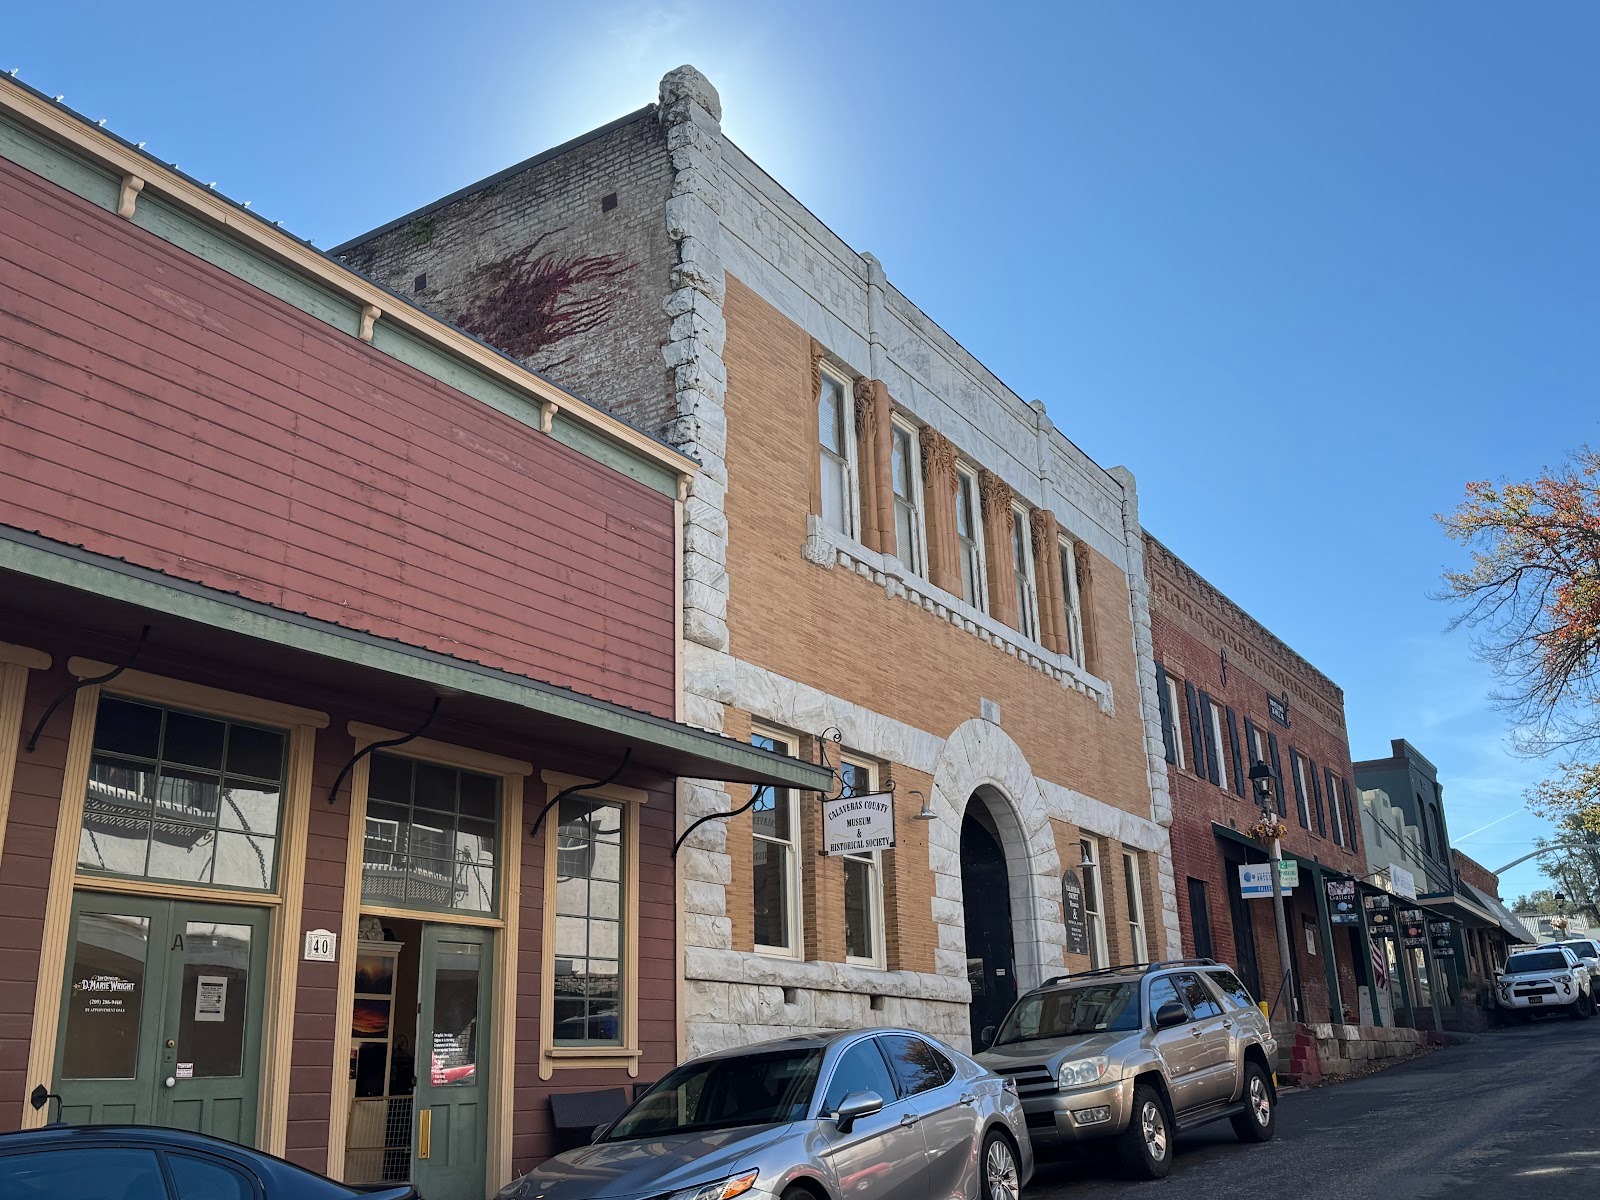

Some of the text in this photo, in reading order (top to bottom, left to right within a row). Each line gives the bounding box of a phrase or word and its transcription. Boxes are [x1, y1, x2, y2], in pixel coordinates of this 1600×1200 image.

[828, 801, 889, 820] CALAVERAS COUNTY
[847, 817, 871, 827] MUSEUM
[857, 829, 861, 838] &
[830, 837, 889, 851] HISTORICAL SOCIETY
[1073, 908, 1078, 920] &
[171, 934, 184, 951] A
[313, 939, 328, 954] 40
[89, 980, 110, 991] MARIE
[110, 981, 135, 992] WRIGHT
